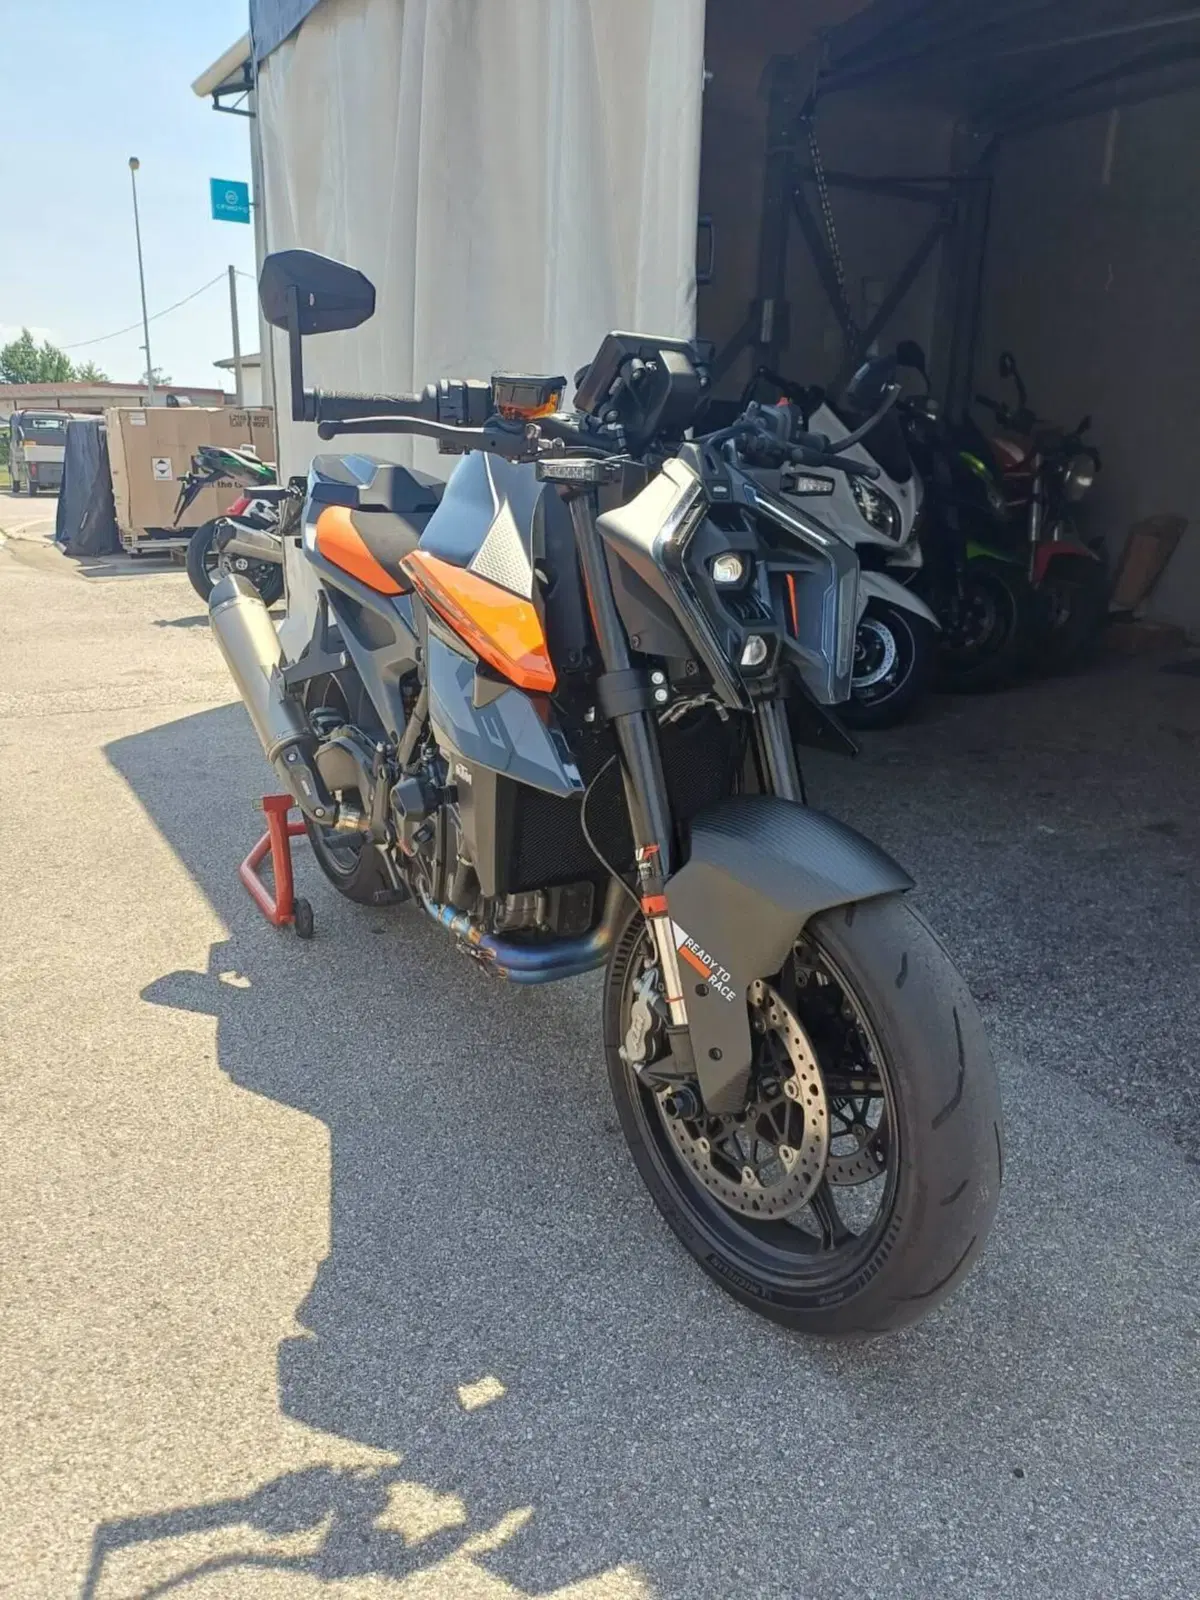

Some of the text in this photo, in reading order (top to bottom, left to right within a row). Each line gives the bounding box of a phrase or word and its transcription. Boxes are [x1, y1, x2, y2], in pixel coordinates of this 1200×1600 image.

[455, 763, 472, 786] KTM
[685, 937, 731, 983] READY TO
[708, 974, 737, 1002] RACE
